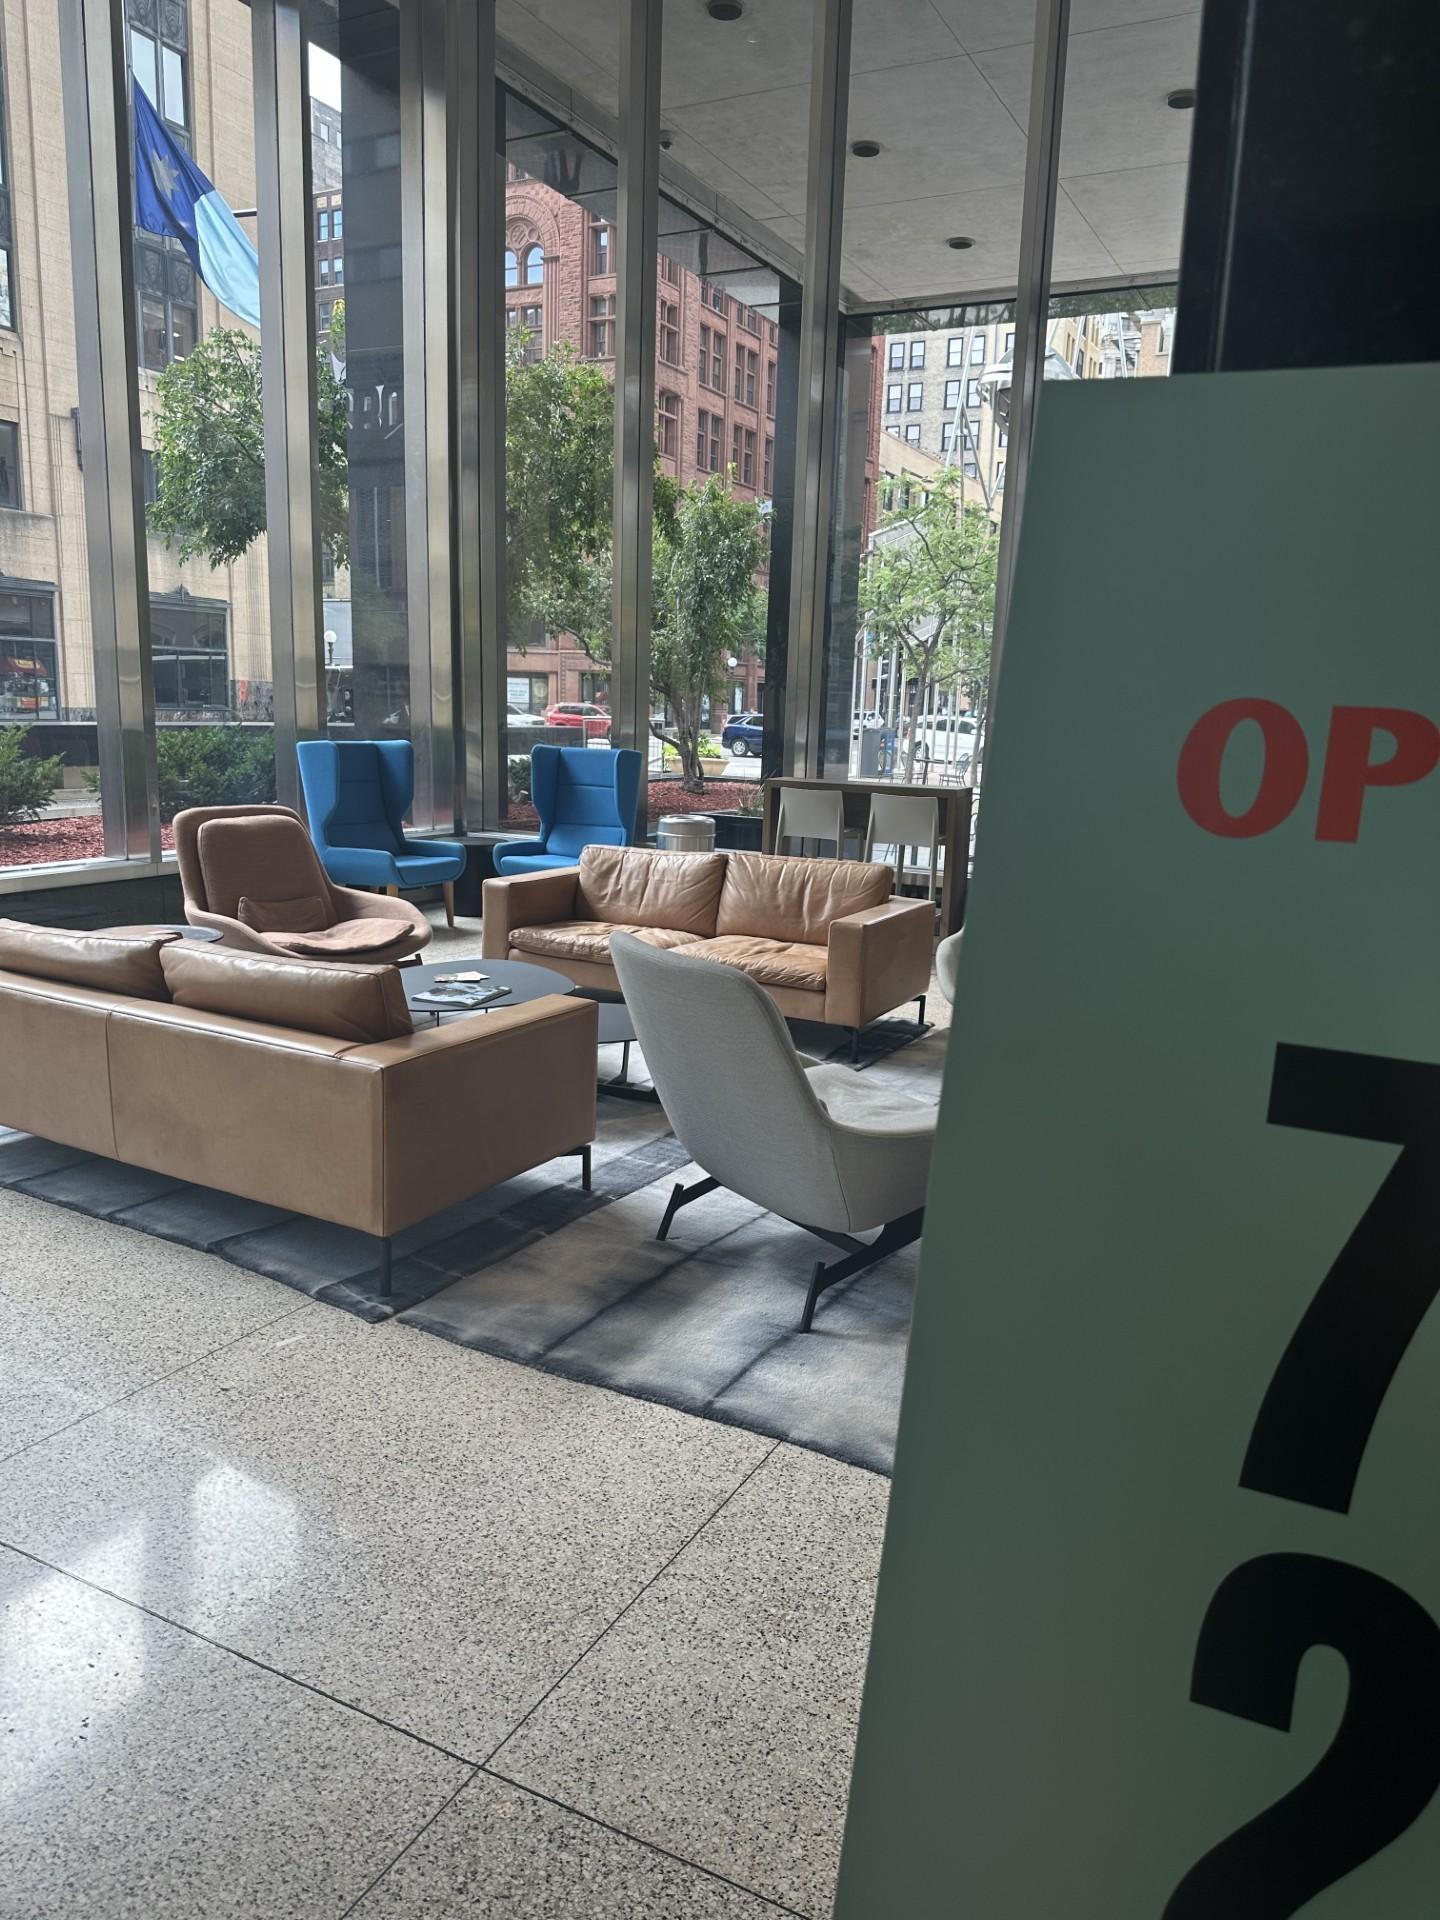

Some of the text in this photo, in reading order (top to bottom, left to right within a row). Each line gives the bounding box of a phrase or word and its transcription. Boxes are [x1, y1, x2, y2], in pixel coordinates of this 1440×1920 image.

[1176, 697, 1440, 844] OP
[1238, 1042, 1440, 1516] 7
[1160, 1552, 1440, 1920] 2
